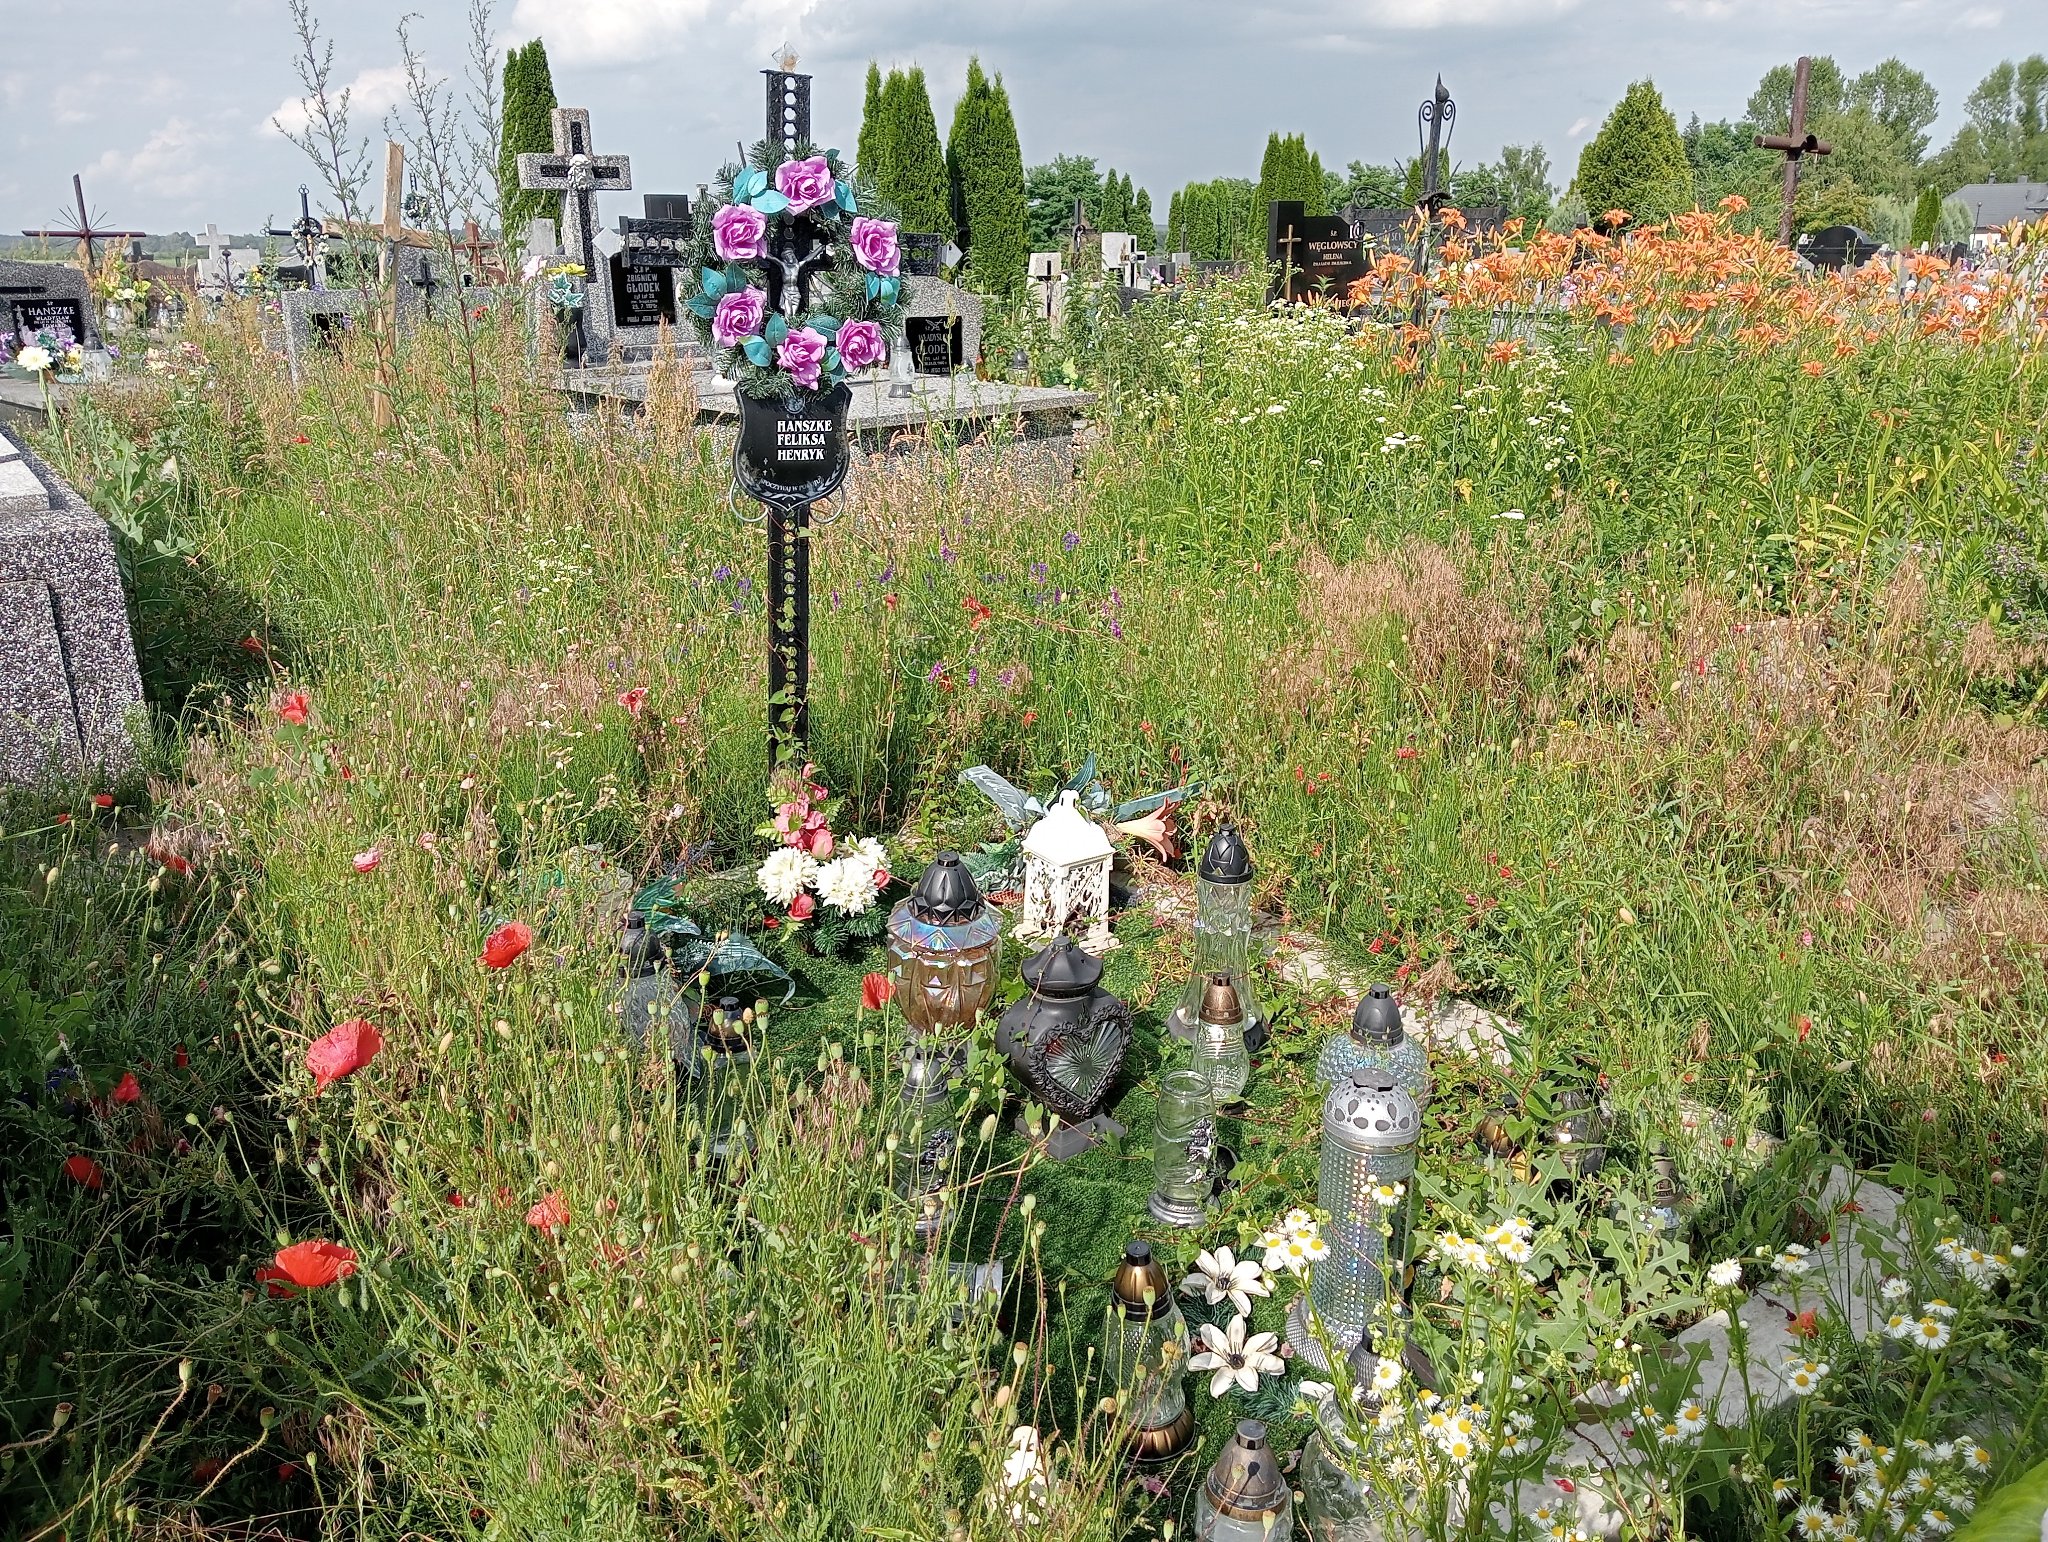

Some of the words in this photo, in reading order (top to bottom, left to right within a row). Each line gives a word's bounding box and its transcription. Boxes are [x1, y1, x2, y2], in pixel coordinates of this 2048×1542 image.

[626, 274, 658, 282] ZBIGNIEW
[626, 283, 660, 293] GŁODEK
[28, 306, 75, 316] HANSZKE
[777, 420, 833, 433] HANSZKE
[777, 433, 825, 446] FELIKSA
[777, 448, 824, 461] HENRYK
